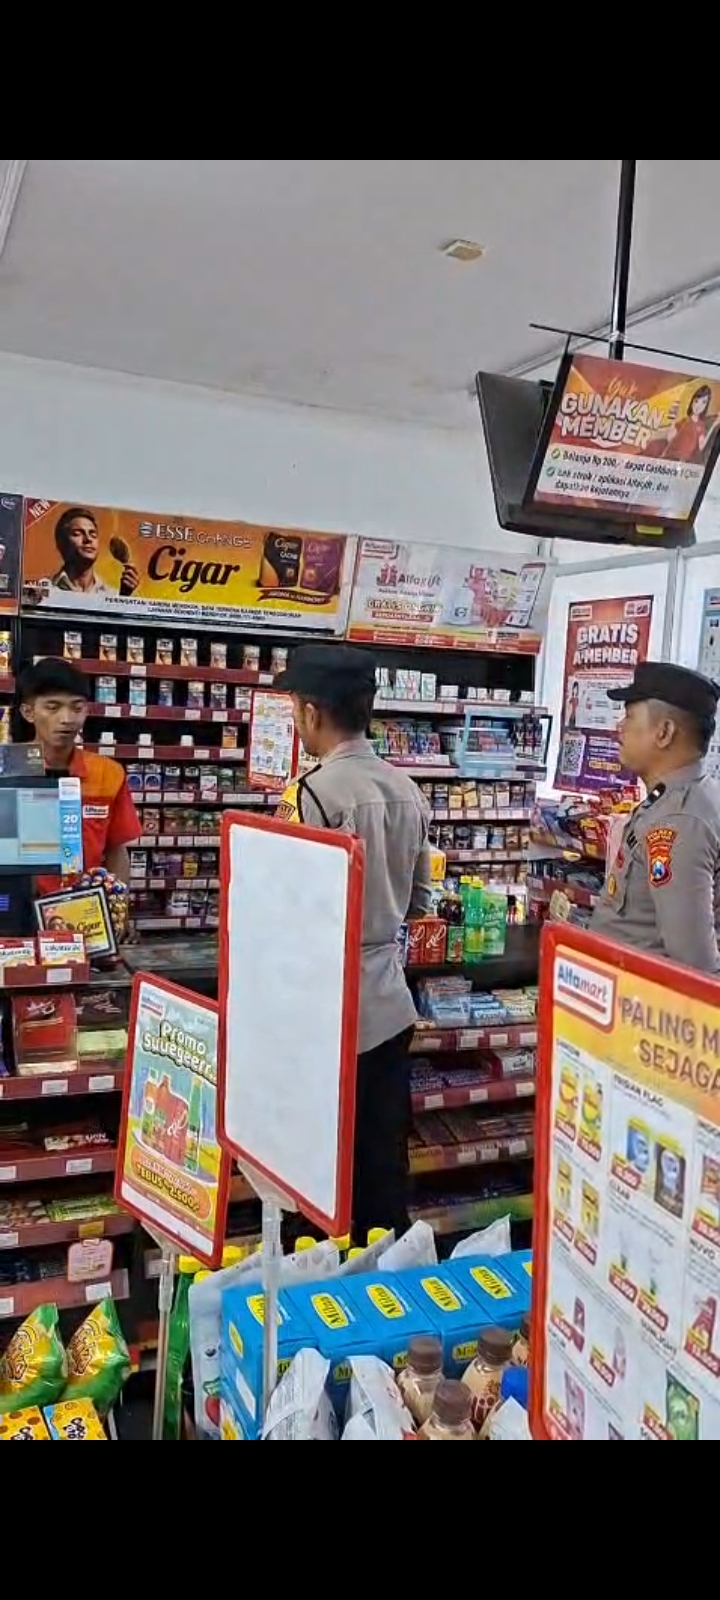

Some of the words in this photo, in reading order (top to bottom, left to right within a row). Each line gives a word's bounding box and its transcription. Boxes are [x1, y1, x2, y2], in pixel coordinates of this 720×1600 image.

[561, 392, 664, 429] GUNAKAN
[562, 415, 651, 450] MEMBER
[28, 500, 51, 518] NEW
[156, 523, 194, 542] ESSE
[147, 545, 240, 593] Cigar
[577, 623, 638, 644] GRATIS
[63, 814, 78, 823] 20
[557, 964, 608, 1003] Alfamart
[161, 1020, 207, 1055] Promo
[136, 1163, 163, 1188] TEBUS
[690, 1238, 717, 1260] NUVO
